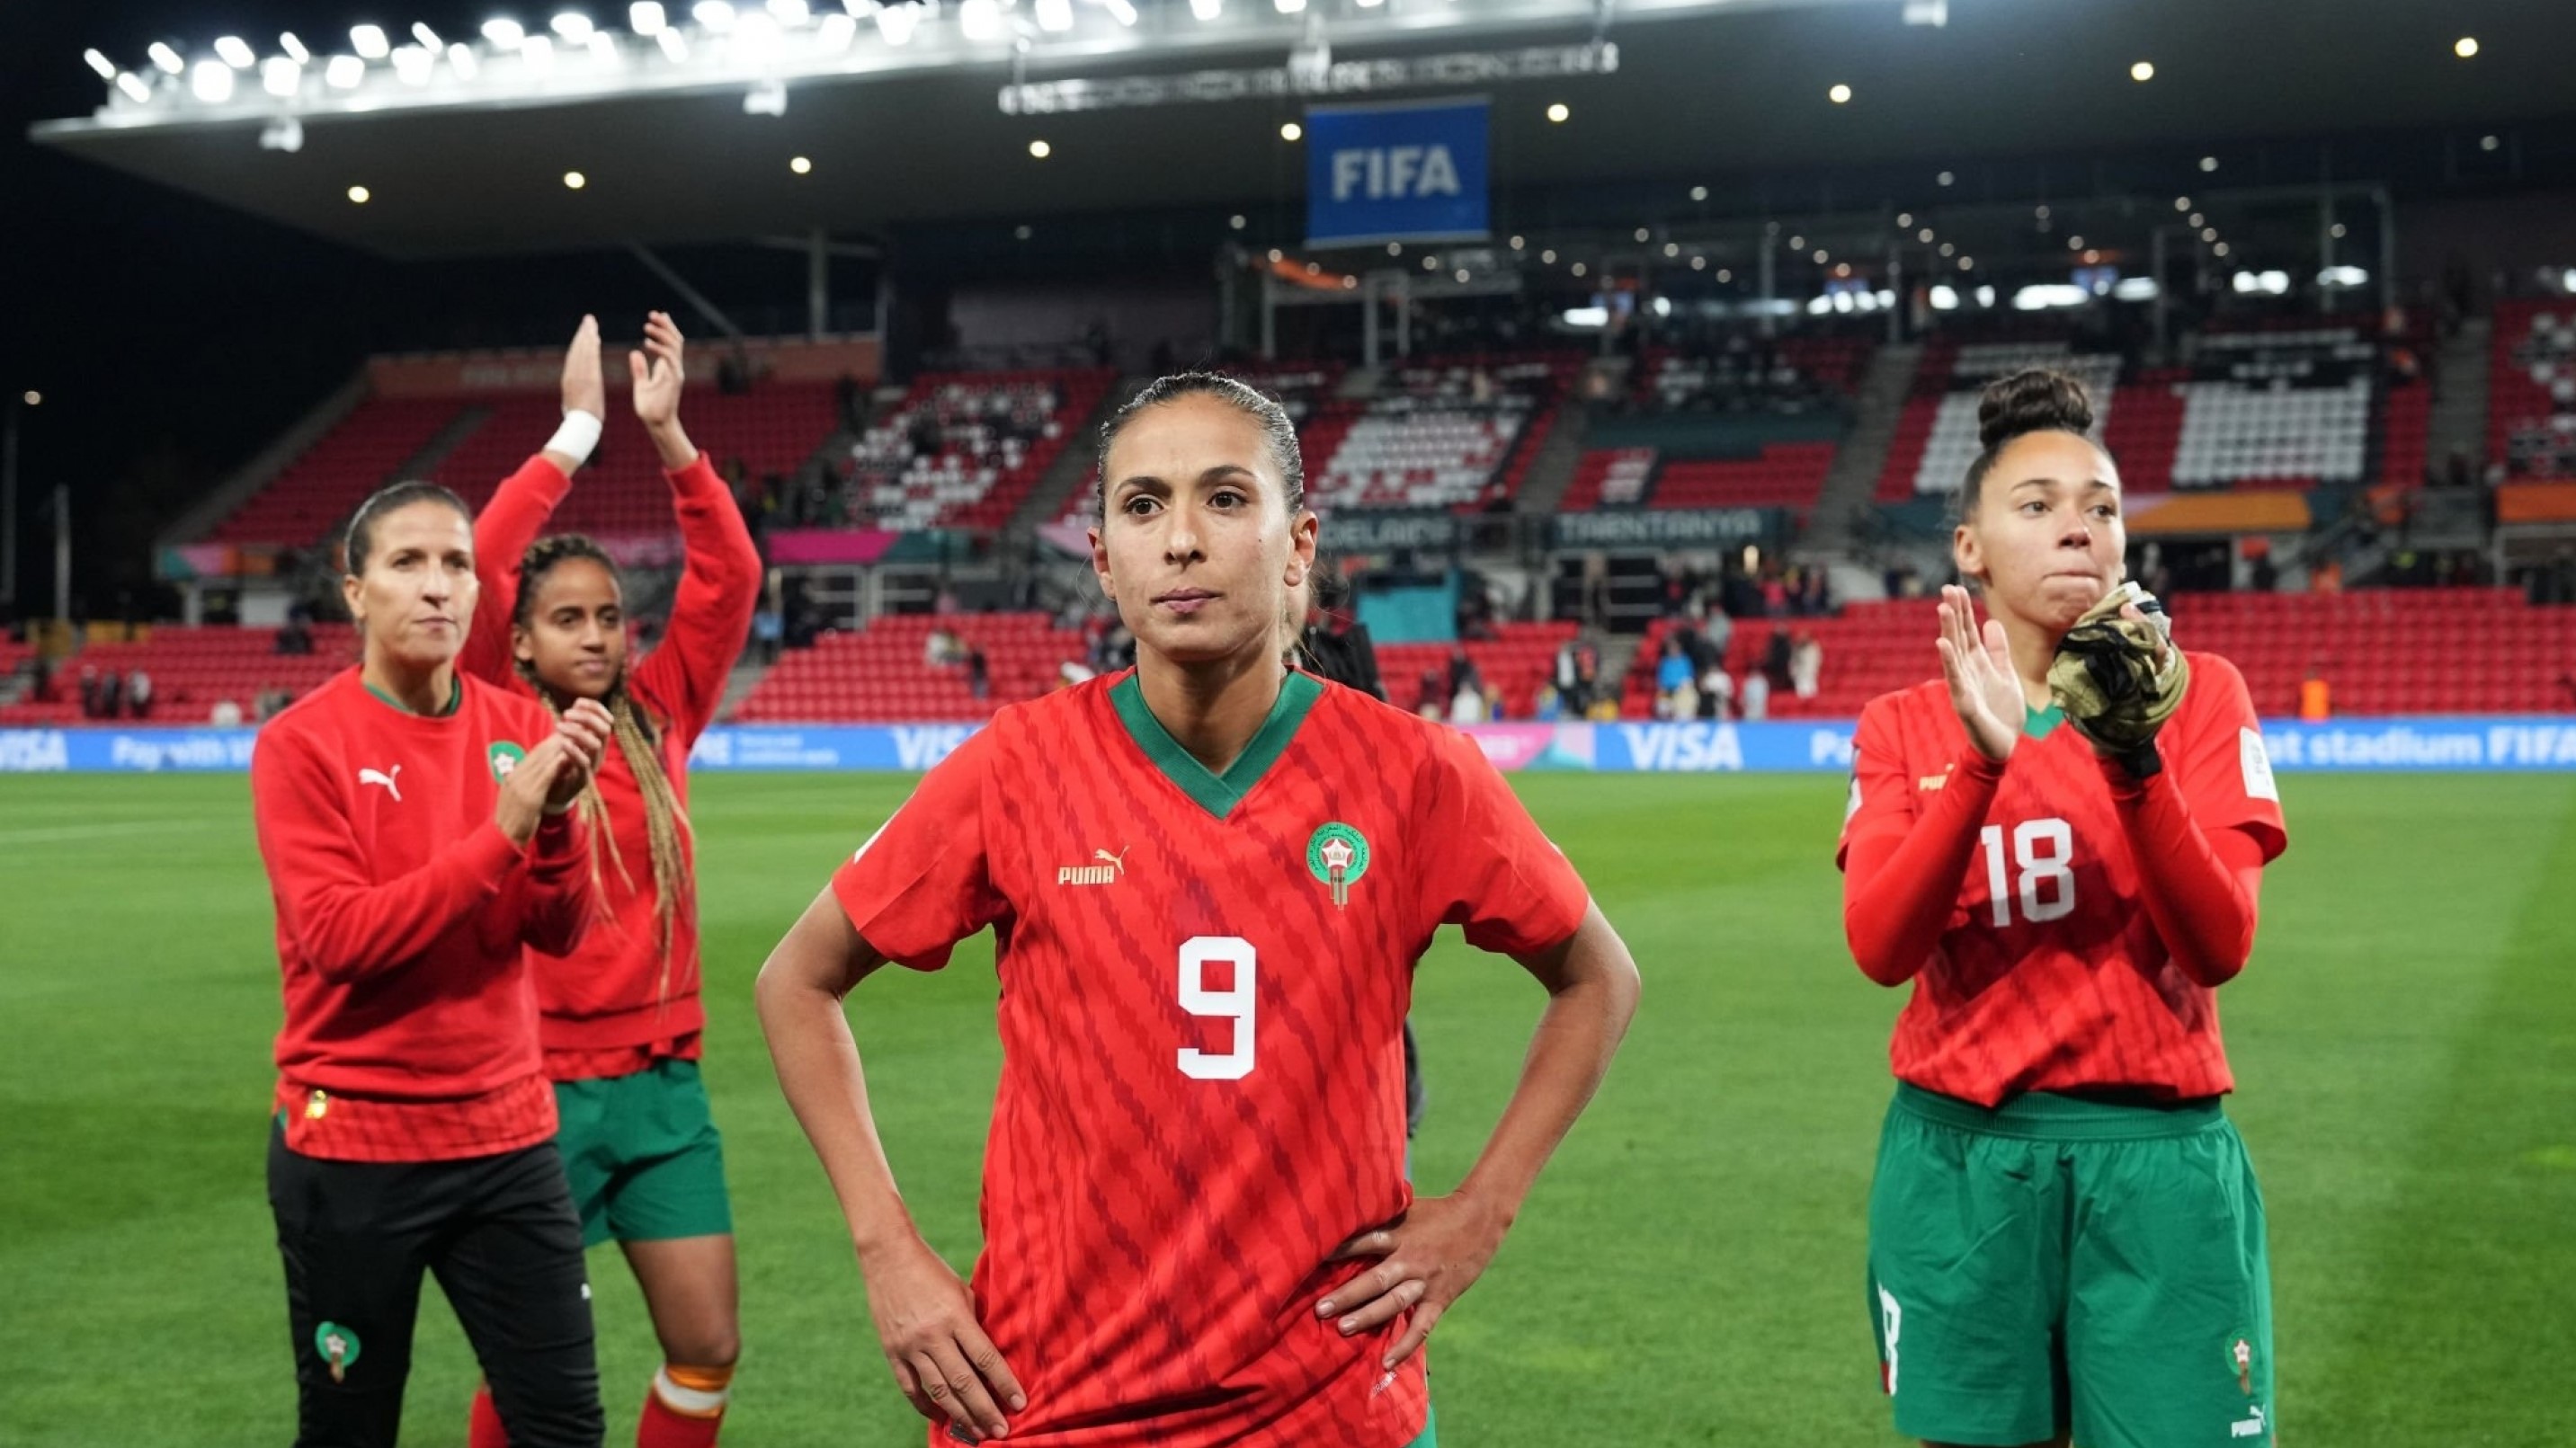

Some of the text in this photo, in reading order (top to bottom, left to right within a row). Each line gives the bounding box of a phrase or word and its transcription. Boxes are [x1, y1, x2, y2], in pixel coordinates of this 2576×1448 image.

[1331, 145, 1462, 203] FIFA
[1620, 724, 1744, 770] VISA
[1810, 730, 1853, 766] Pa
[2309, 725, 2482, 765] stadium
[1057, 865, 1115, 886] PUMA
[1981, 818, 2075, 928] 18
[1177, 936, 1257, 1079] 9
